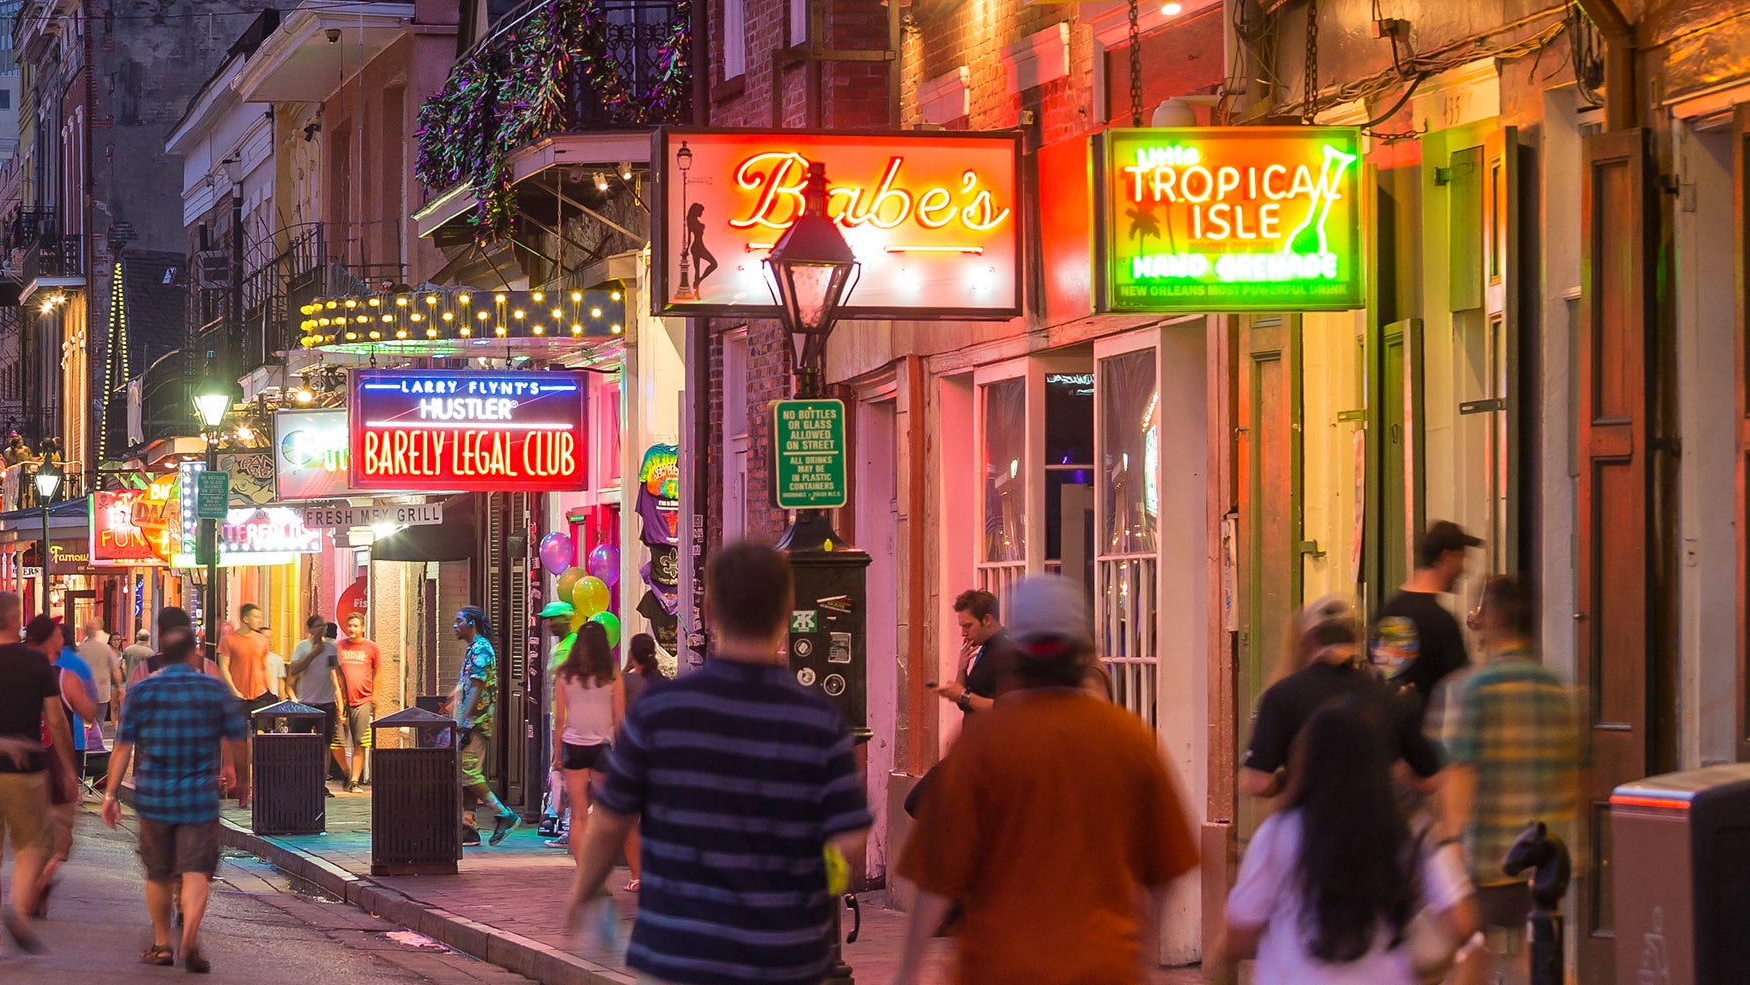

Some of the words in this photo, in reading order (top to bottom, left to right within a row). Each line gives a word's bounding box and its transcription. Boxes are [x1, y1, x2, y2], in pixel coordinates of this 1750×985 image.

[1125, 165, 1341, 202] TROPICAL
[730, 152, 1010, 230] Babe's
[1193, 203, 1281, 239] ISLE
[1133, 254, 1207, 278] HAND
[1216, 253, 1337, 281] GRENADE
[1121, 286, 1146, 296] NEW
[1150, 286, 1204, 296] ORLEANS
[1208, 286, 1239, 296] MOST
[1310, 284, 1346, 295] DRINK
[402, 380, 457, 394] LARRY
[469, 382, 539, 395] FLYNT'S
[783, 410, 795, 420] NO
[799, 410, 836, 419] BOTTLES
[788, 421, 800, 429] OR
[804, 420, 832, 429] GLASS
[791, 430, 831, 439] ALLOWED
[787, 441, 799, 450] ON
[803, 440, 834, 449] STREET
[365, 430, 445, 475] BARELY
[453, 429, 517, 476] LEGAL
[523, 429, 575, 476] CLUB
[806, 456, 832, 464] DRINKS
[789, 482, 834, 490] CONTAINERS
[307, 510, 352, 525] FRESH
[361, 509, 389, 523] MEX
[397, 506, 439, 521] GRILL
